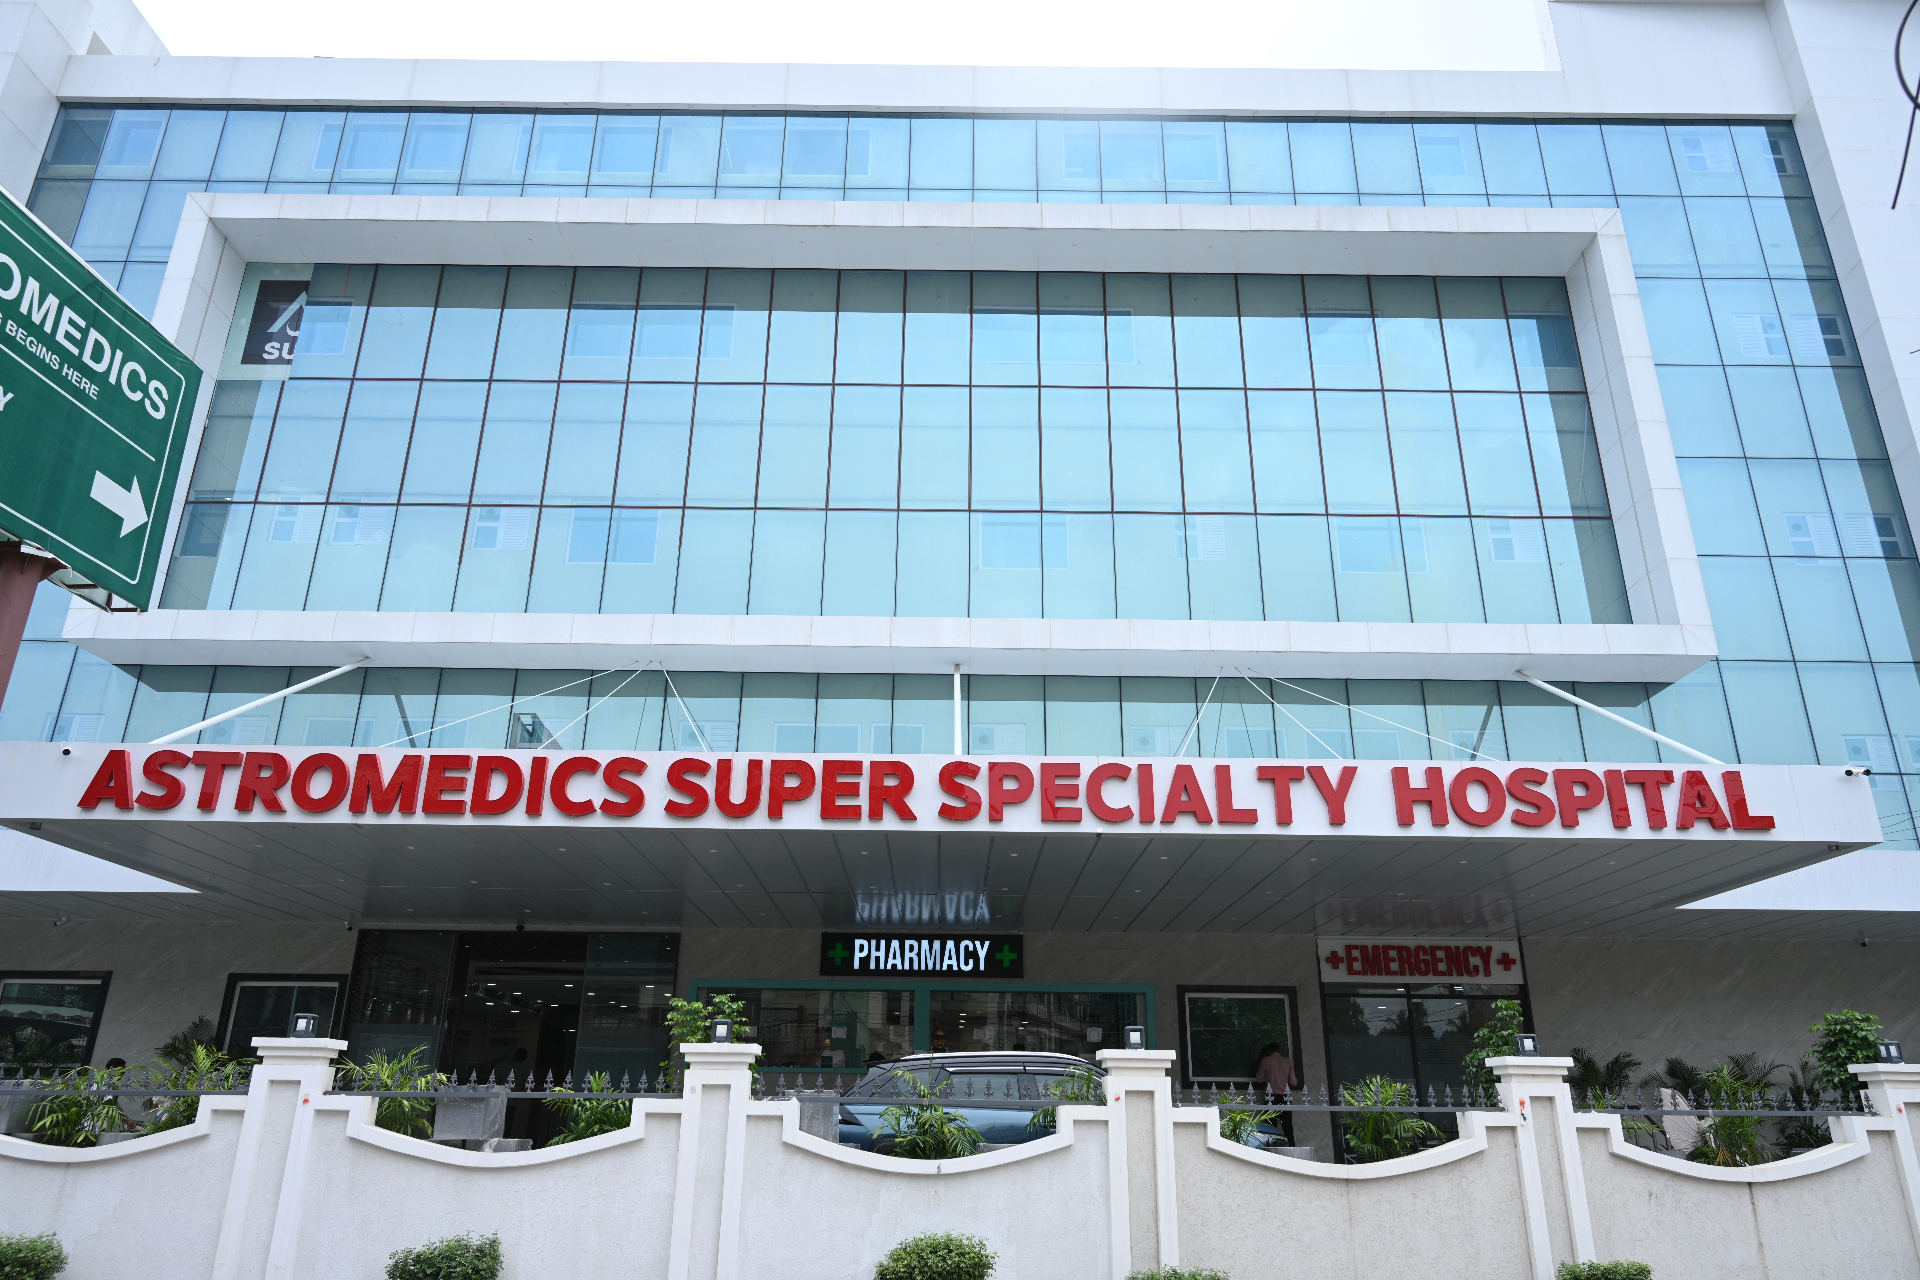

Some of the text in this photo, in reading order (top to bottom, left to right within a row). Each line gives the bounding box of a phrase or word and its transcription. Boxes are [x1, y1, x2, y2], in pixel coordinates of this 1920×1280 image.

[5, 319, 100, 400] BEGINS HERE
[77, 749, 1777, 830] ASTROMEDICS SUPER SPECIALTY HOSPITAL
[853, 938, 991, 972] PHARMACY
[1345, 944, 1493, 978] EMERGENCY
